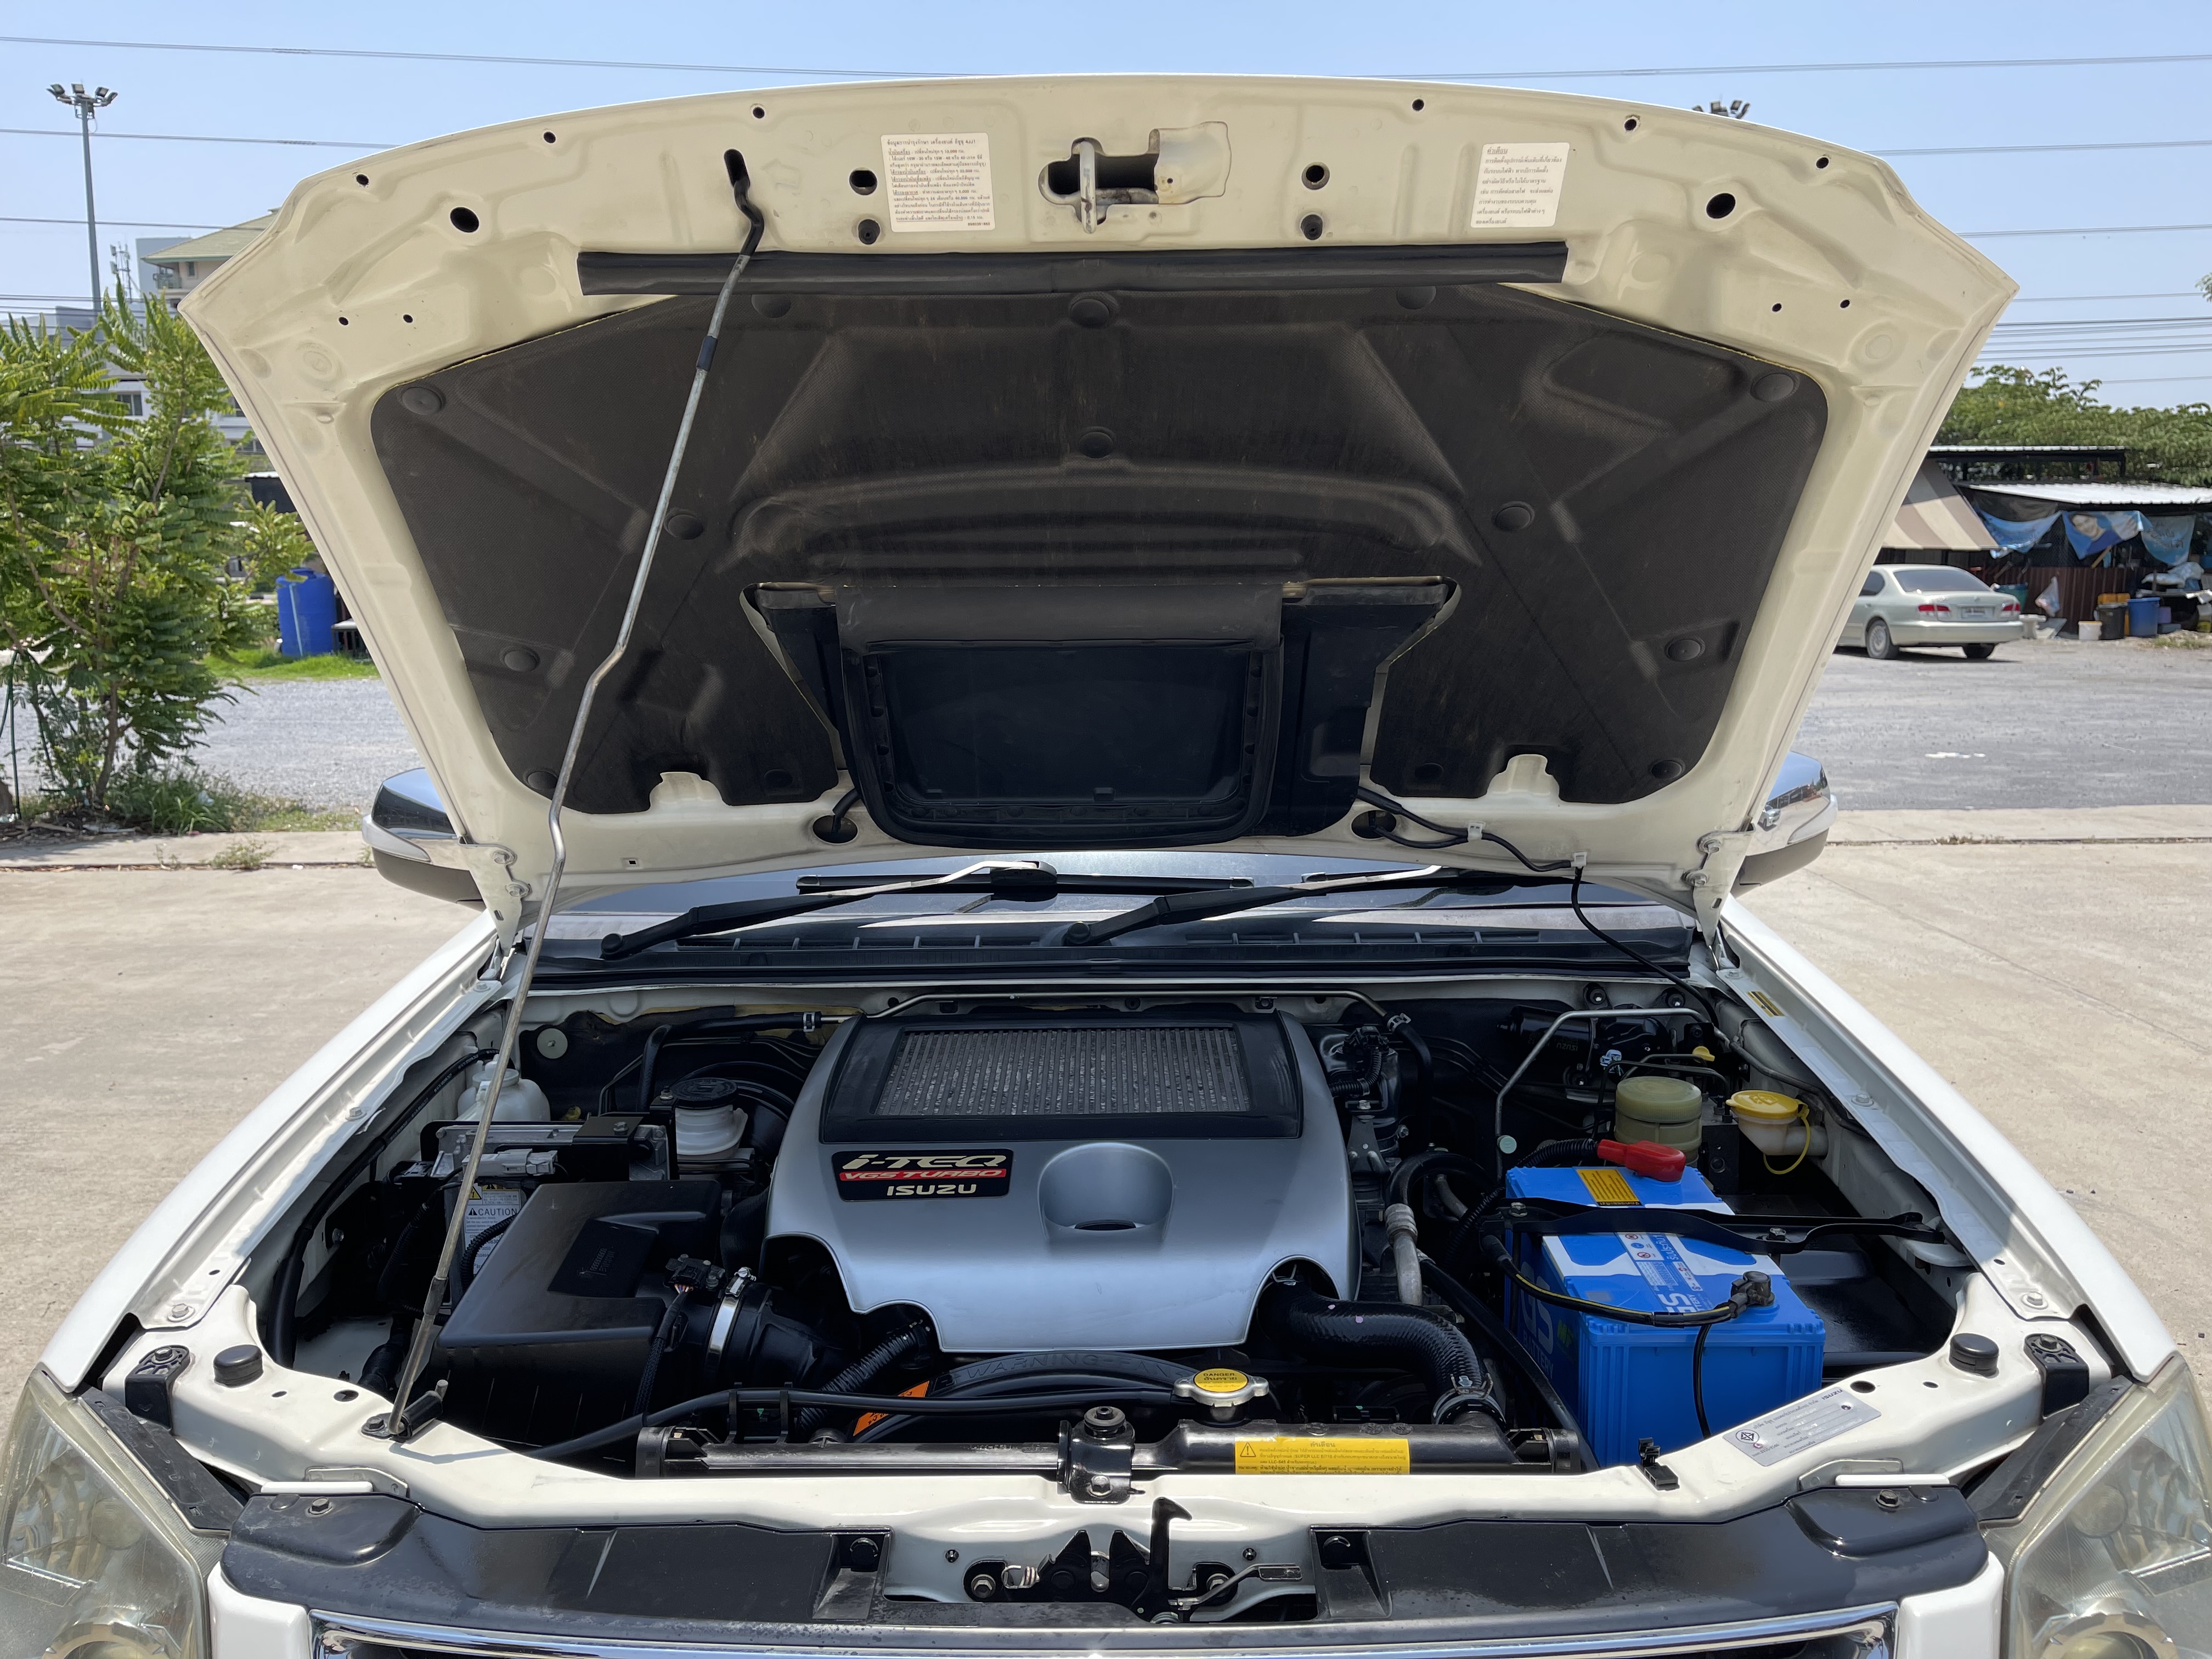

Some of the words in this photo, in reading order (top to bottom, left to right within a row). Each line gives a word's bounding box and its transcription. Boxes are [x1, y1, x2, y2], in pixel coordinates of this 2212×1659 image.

[1487, 146, 1508, 154] คำเตือน
[902, 1170, 1001, 1179] TURBO
[887, 1184, 977, 1196] ISUZU
[1523, 1329, 1554, 1380] BATTERY
[1821, 1389, 1843, 1400] ISUZU
